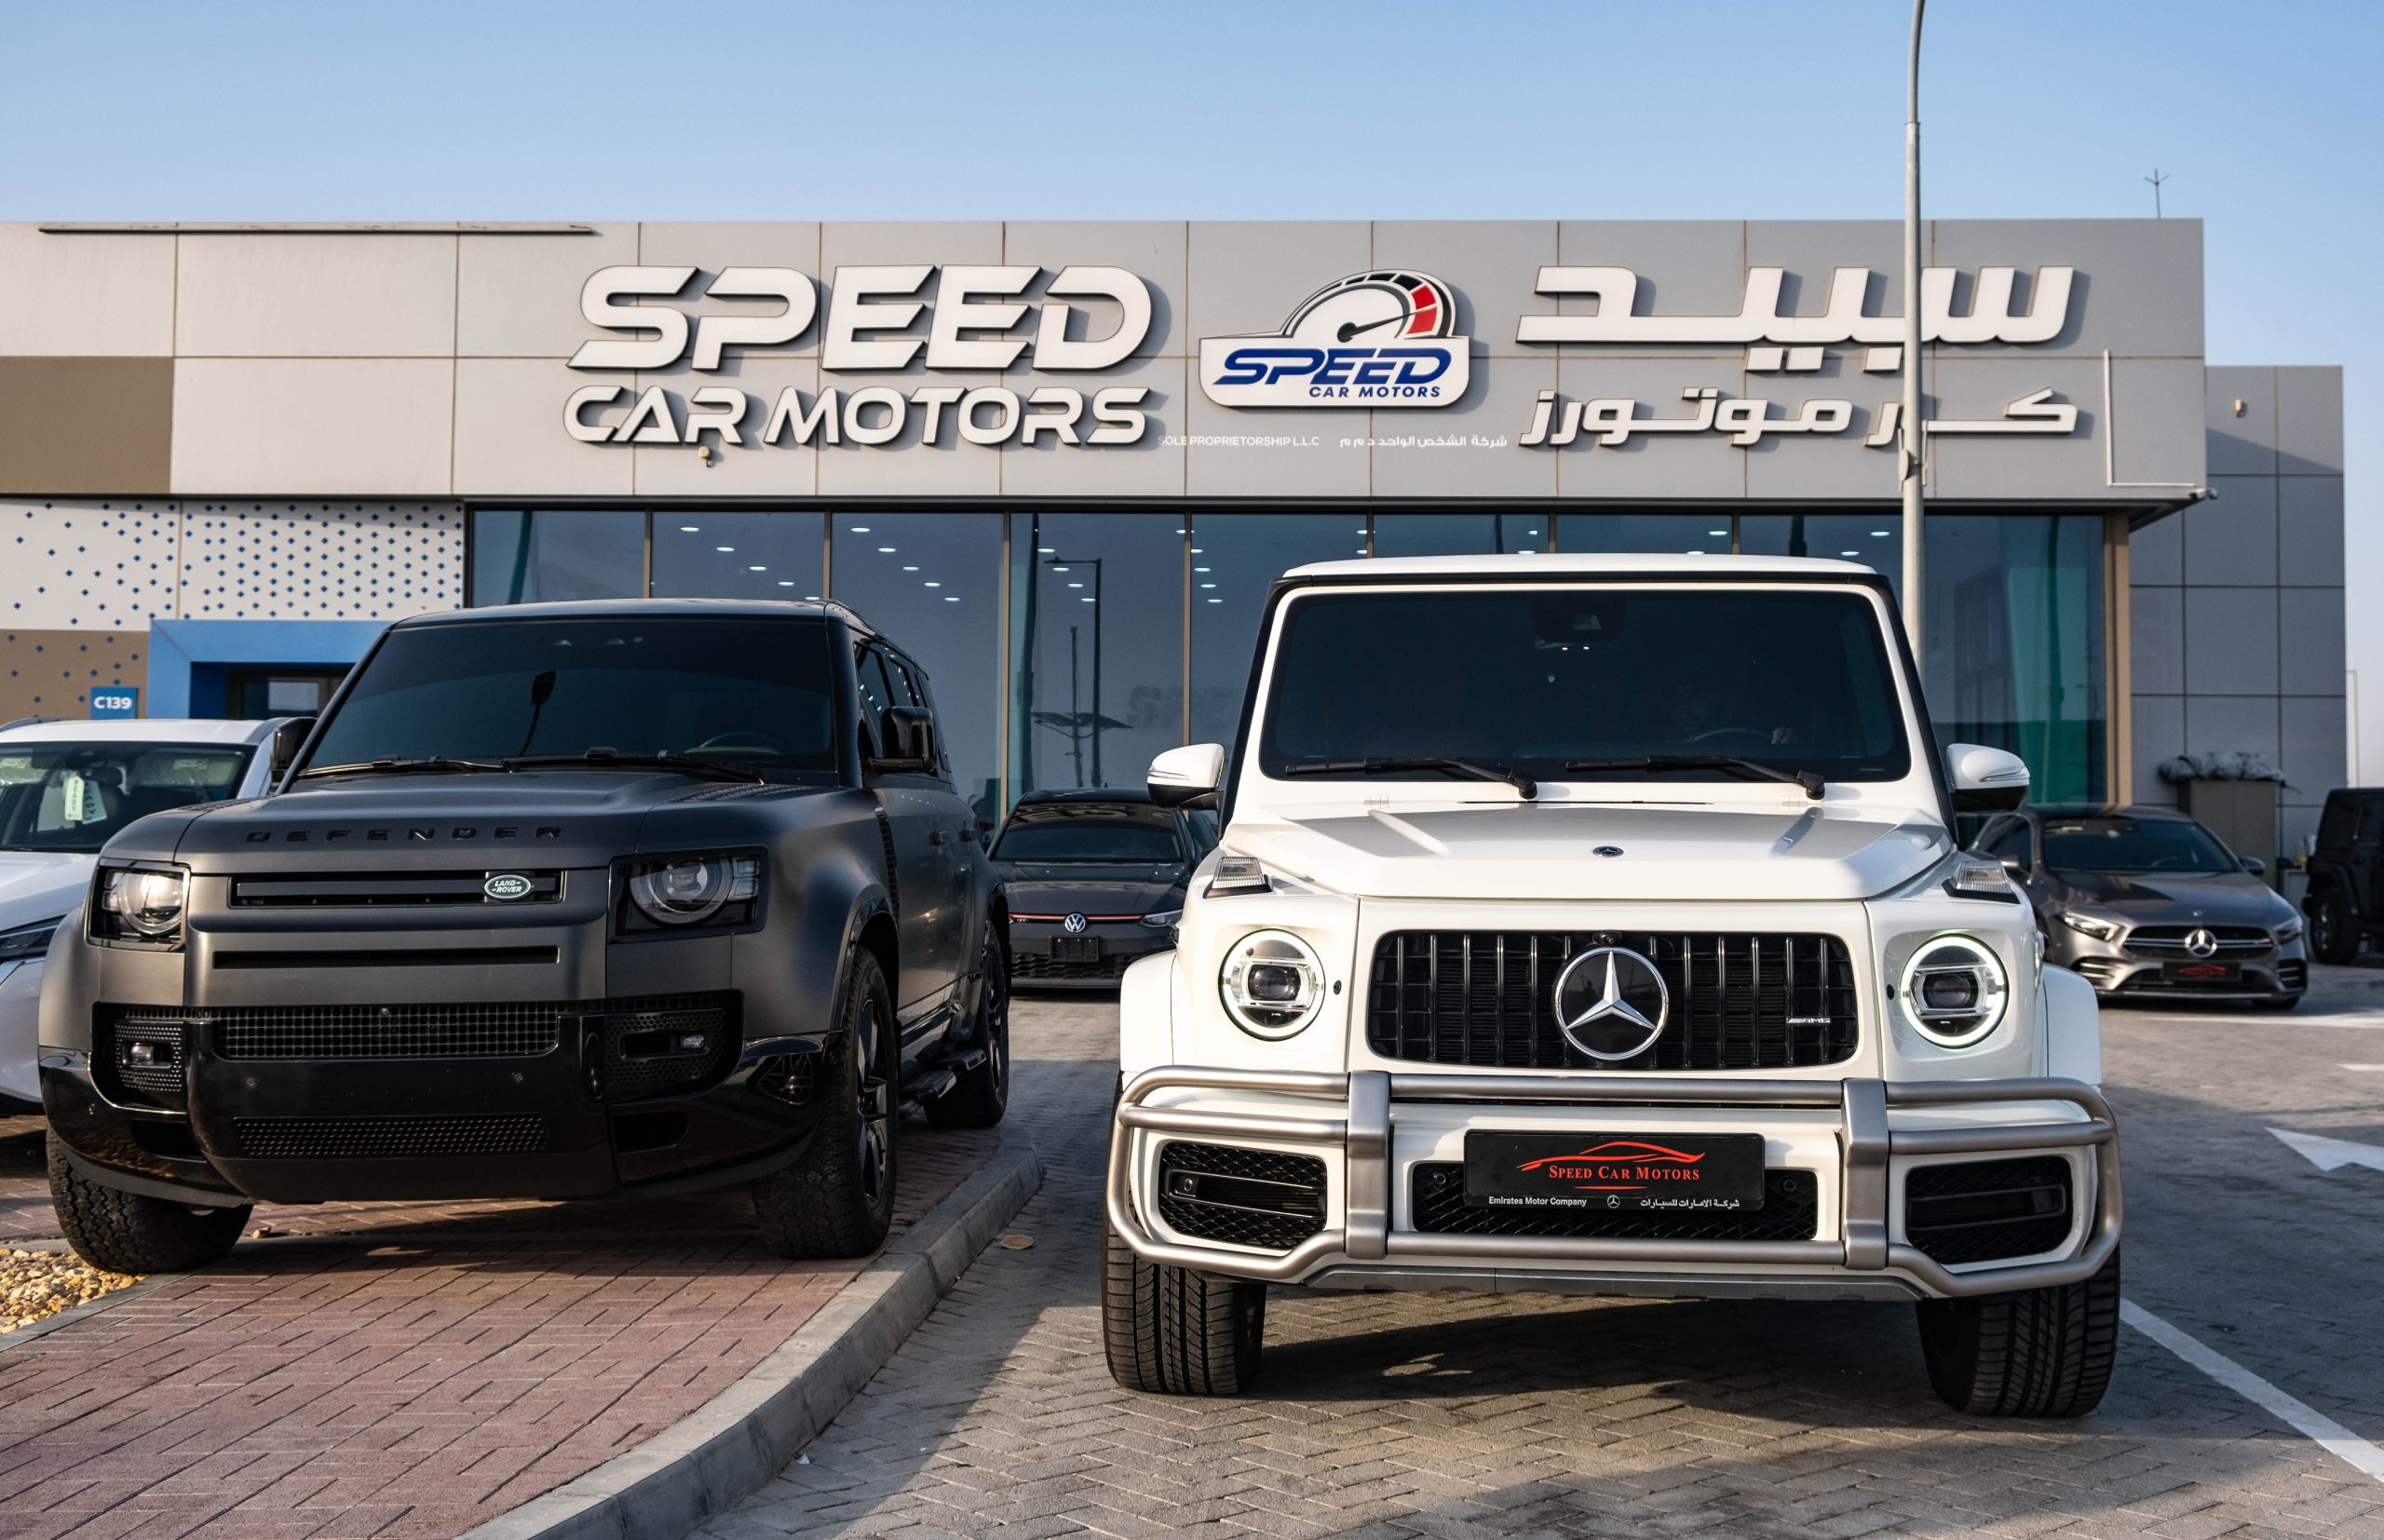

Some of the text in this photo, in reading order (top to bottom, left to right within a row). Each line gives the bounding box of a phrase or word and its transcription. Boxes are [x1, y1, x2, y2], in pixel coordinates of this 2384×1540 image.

[567, 265, 1151, 370] SPEED
[1516, 265, 2074, 371] سبيد
[1212, 347, 1452, 385] SPEED
[1309, 386, 1441, 398] CAR MOTORS
[563, 385, 1145, 443] CAR MOTORS
[1519, 386, 1853, 445] موتورز
[1158, 436, 1320, 446] SOLE PROPRIETORSHIP L.L.C
[1378, 436, 1416, 448] الواحد
[1417, 434, 1466, 447] الشخص
[1470, 435, 1507, 448] شركة
[94, 696, 132, 709] C139
[245, 827, 562, 843] DEFENDER
[1488, 1196, 1524, 1205] Emirates
[1550, 1197, 1588, 1208] Company
